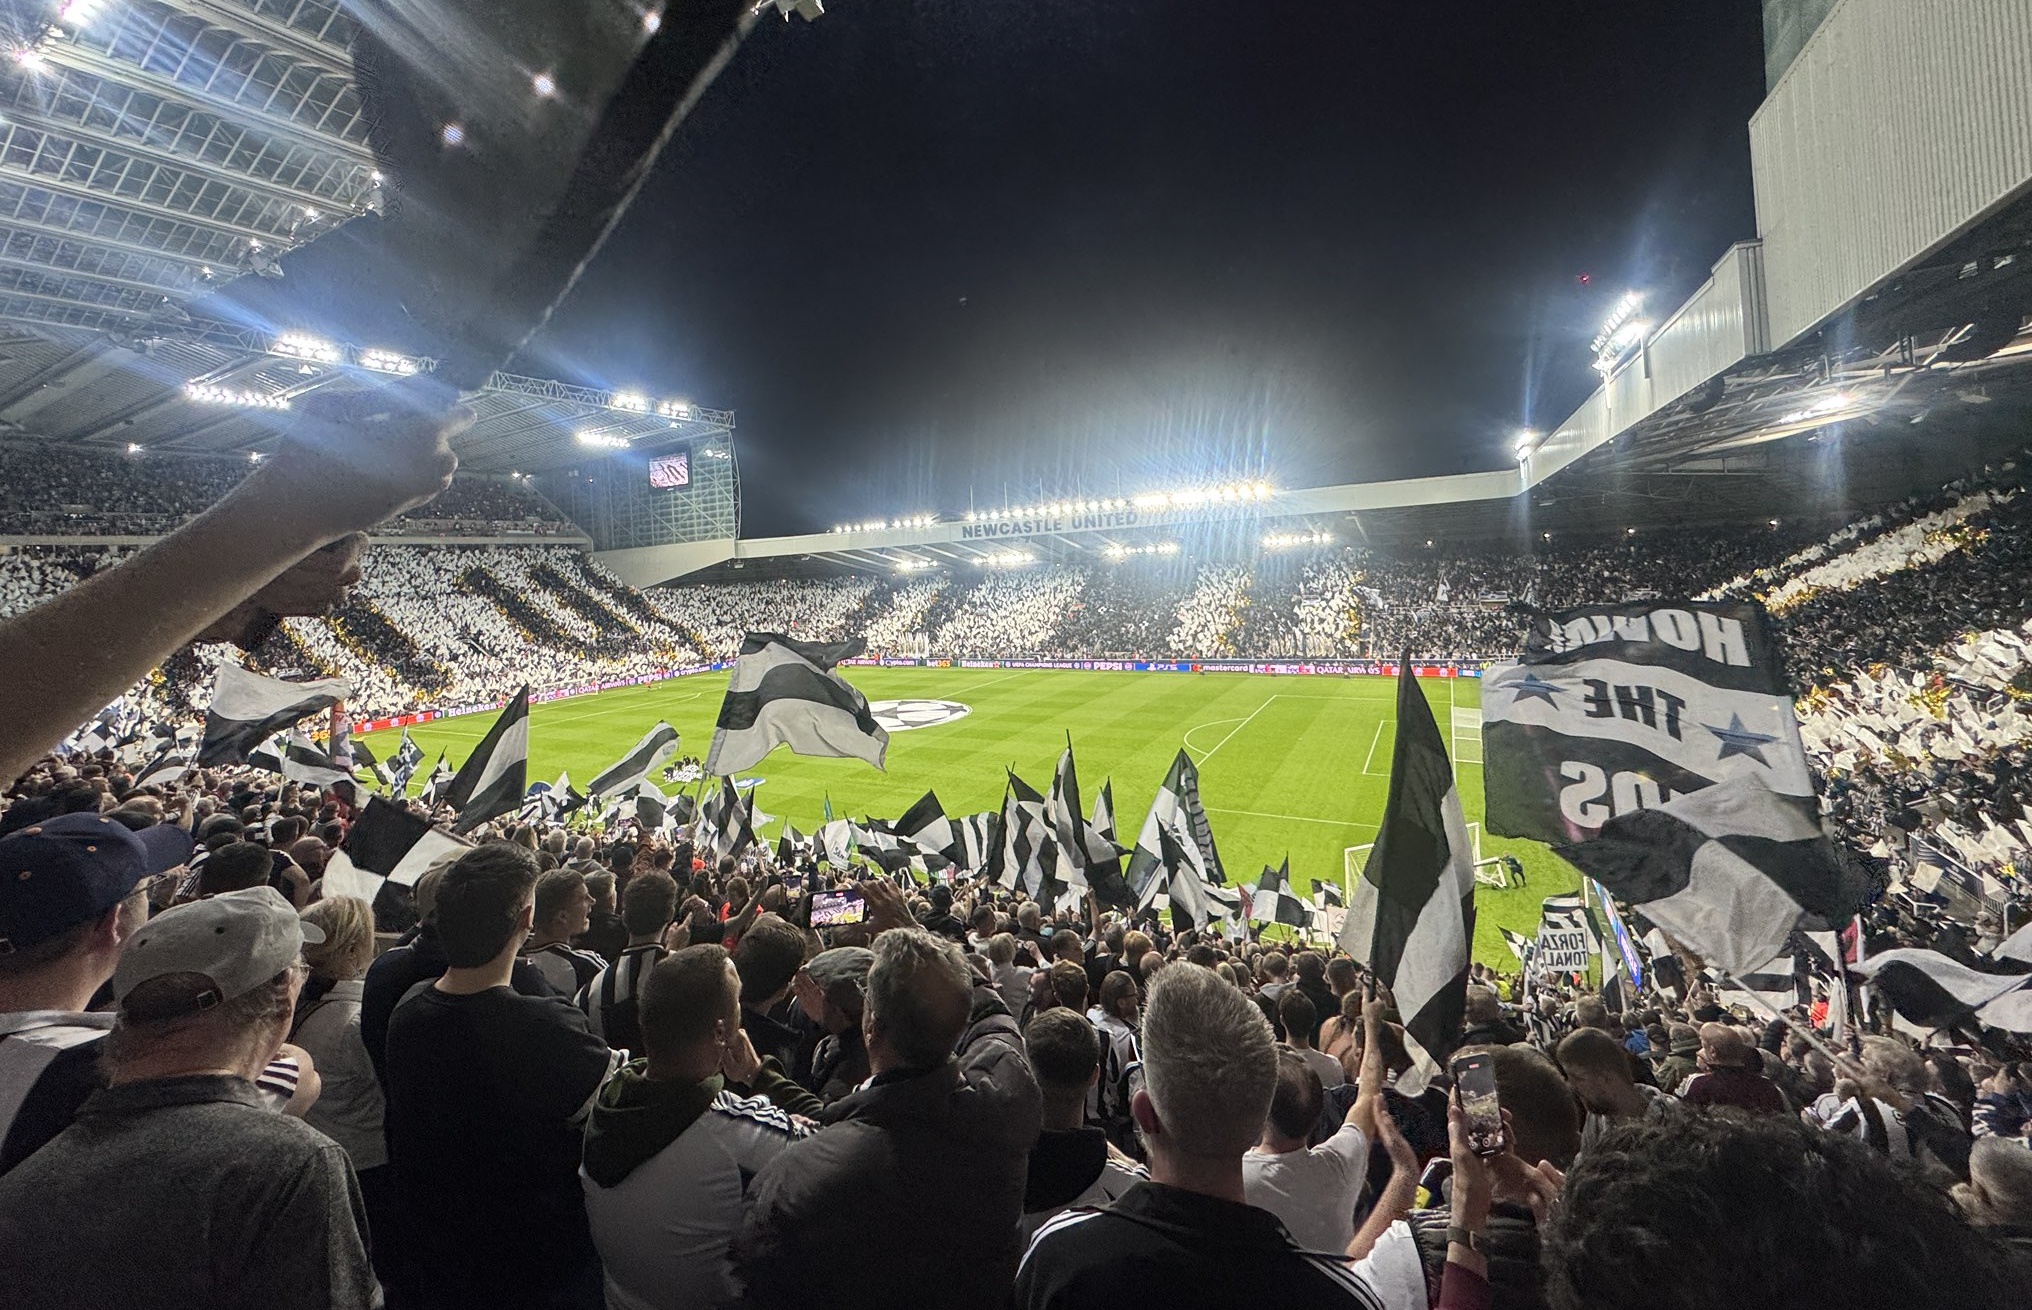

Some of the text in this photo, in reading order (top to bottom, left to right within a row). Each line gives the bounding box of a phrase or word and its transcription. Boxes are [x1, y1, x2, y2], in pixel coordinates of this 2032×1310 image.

[962, 511, 1138, 539] NEWCASTLE UNITED
[926, 659, 951, 668] bet365
[961, 660, 994, 668] Heineken
[1093, 661, 1122, 671] PEPSI
[1202, 663, 1249, 672] mastercard
[680, 665, 711, 676] crypto.com
[1316, 666, 1344, 675] QATAR
[637, 673, 663, 685] PEPSI
[578, 679, 626, 694] QATAR AIRWAYS
[447, 700, 496, 718] Heineken
